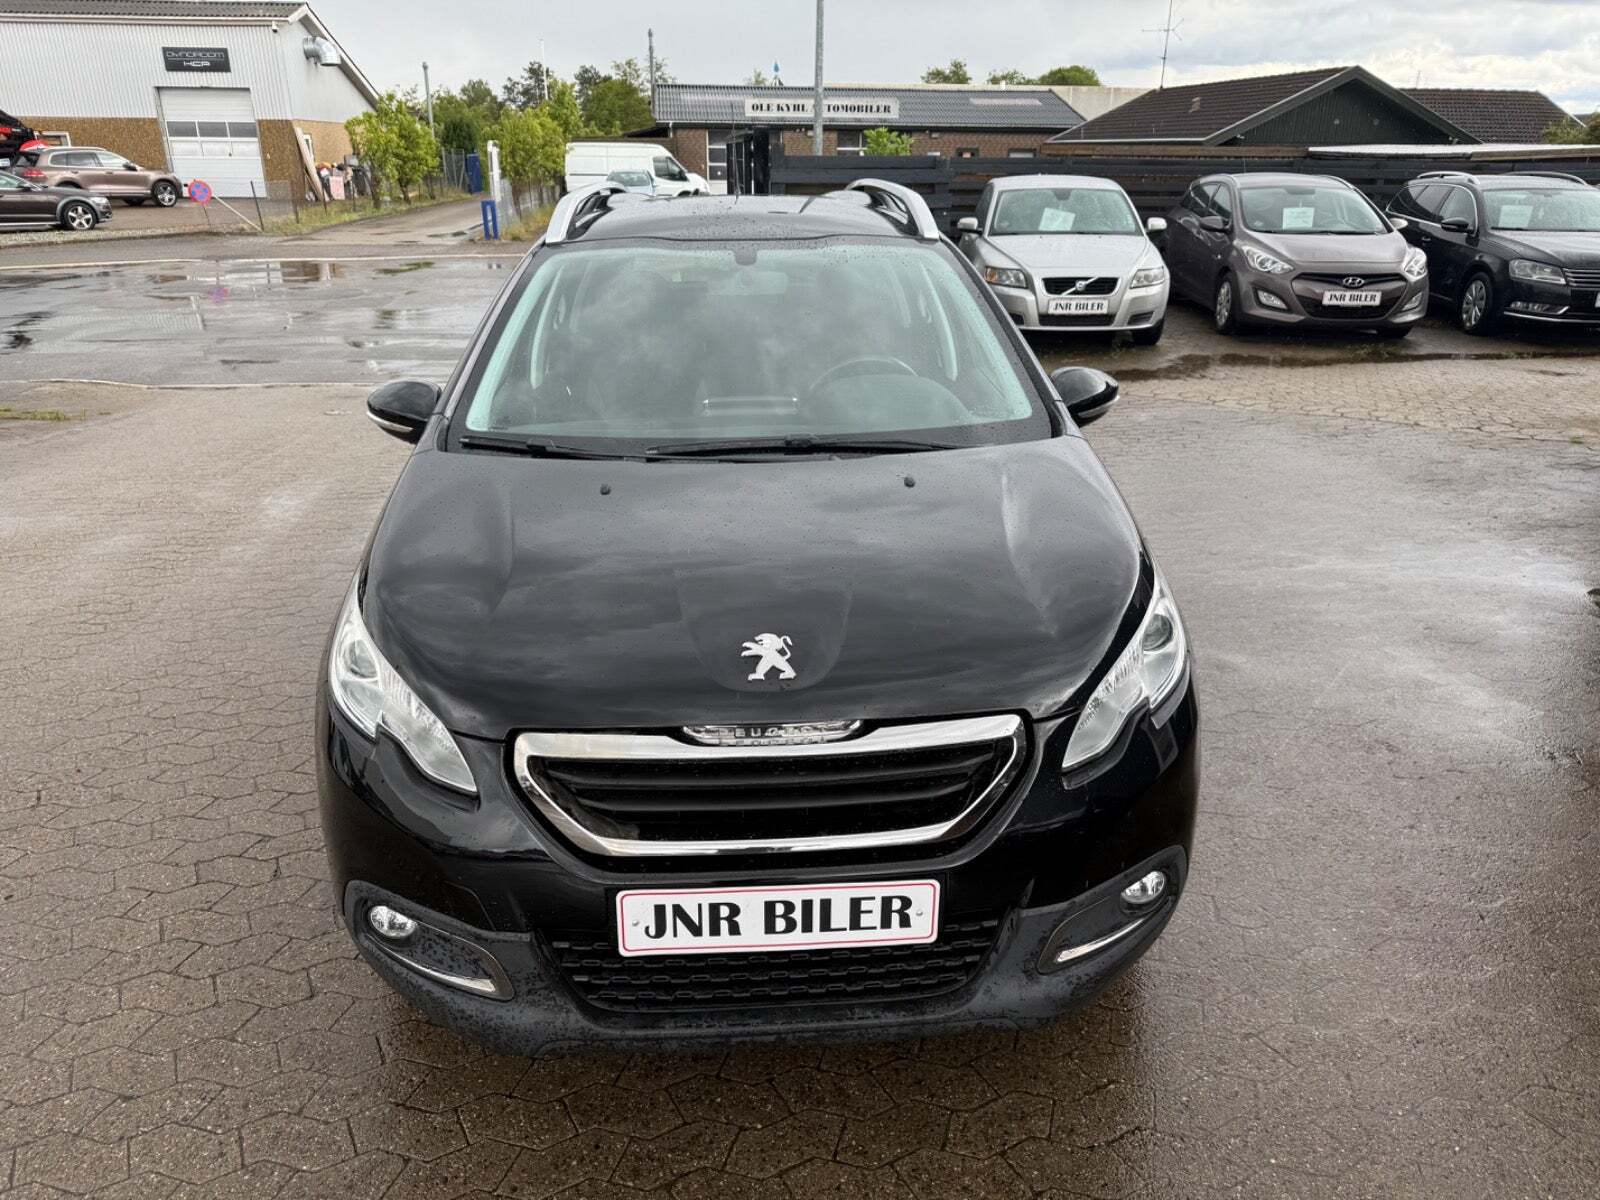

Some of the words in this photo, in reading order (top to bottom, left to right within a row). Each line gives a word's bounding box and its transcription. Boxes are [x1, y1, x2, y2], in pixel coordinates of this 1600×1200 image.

[752, 103, 773, 112] OLE
[811, 103, 891, 113] TOMOBILER
[1328, 293, 1346, 302] JNR
[1349, 293, 1377, 302] BILER
[1053, 302, 1072, 311] JNR
[1075, 302, 1104, 311] BILER
[644, 902, 742, 939] JNR
[764, 895, 913, 935] BILER
